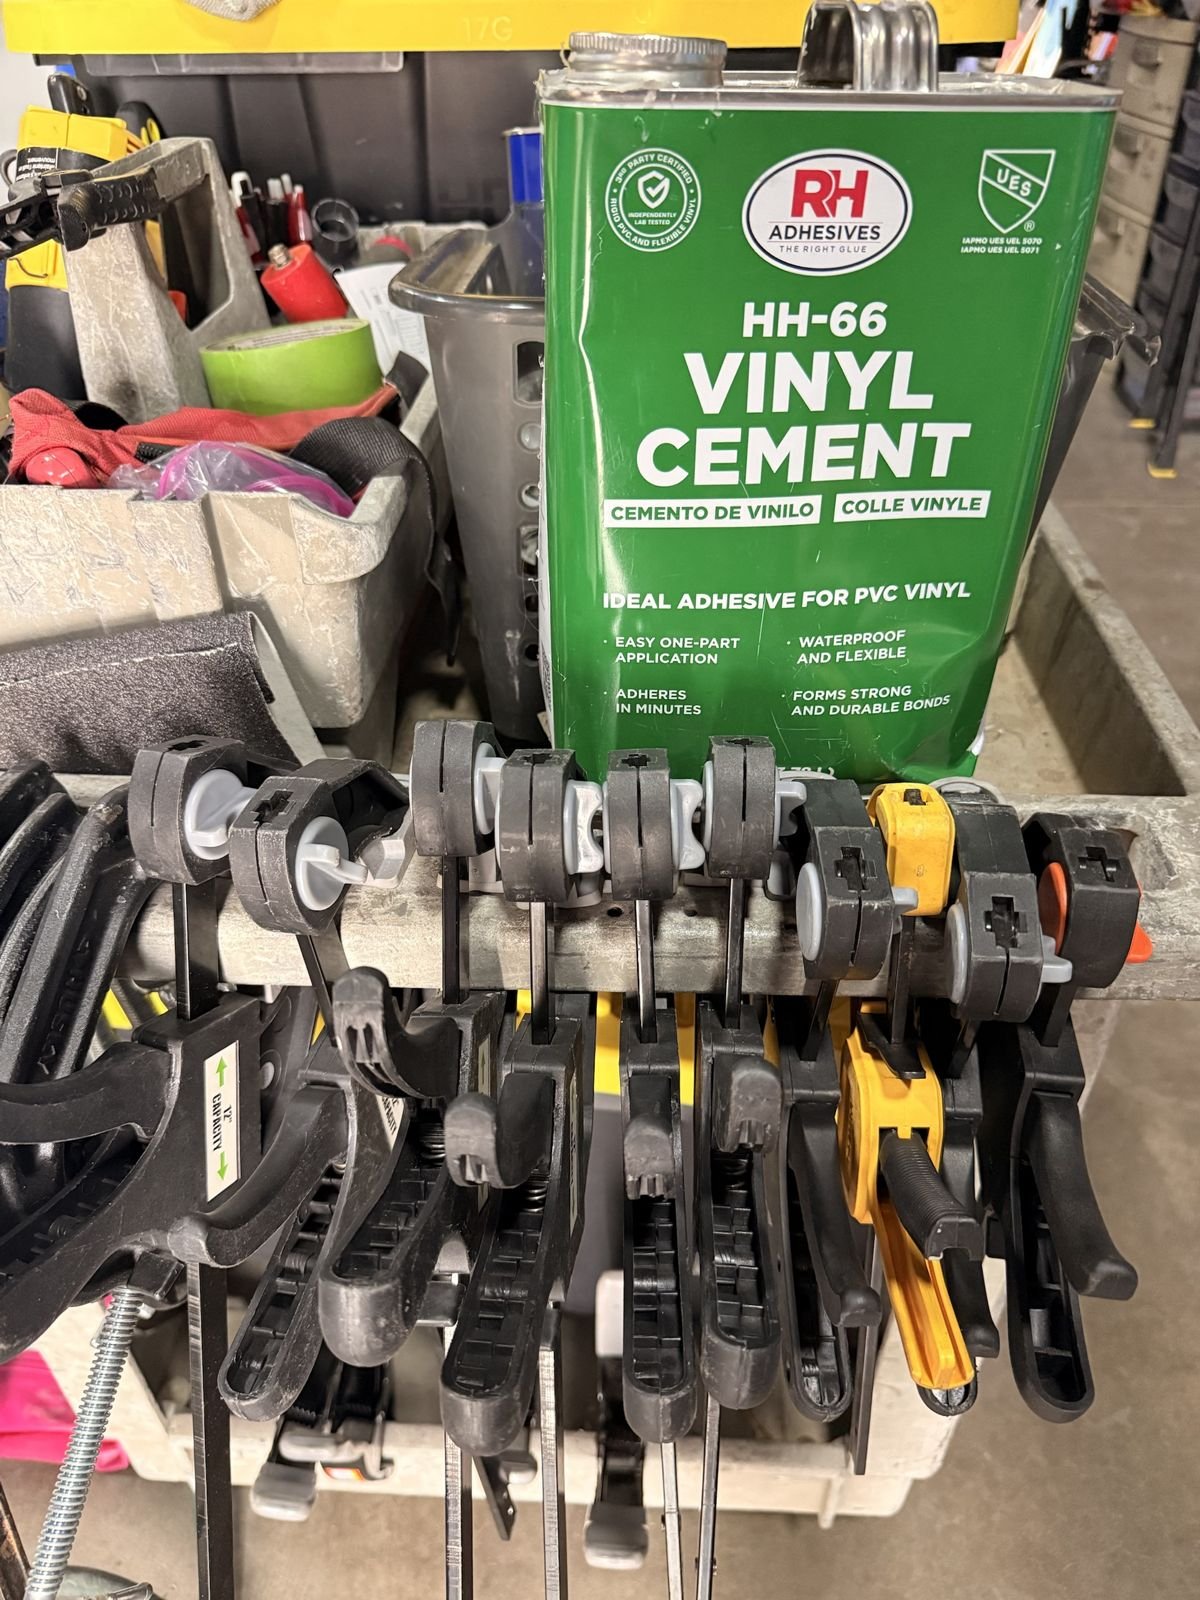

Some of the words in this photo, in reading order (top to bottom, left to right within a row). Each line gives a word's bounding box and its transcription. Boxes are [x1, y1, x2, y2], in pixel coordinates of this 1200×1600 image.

[627, 153, 655, 169] PARTY
[657, 154, 693, 184] CERTIFIED
[996, 168, 1032, 197] UES
[791, 169, 869, 218] RH
[610, 198, 621, 223] RIGID
[617, 223, 633, 239] PVC
[632, 236, 650, 247] AND
[652, 224, 686, 247] FLEXIBLE
[684, 198, 696, 224] VINYL
[769, 225, 881, 241] ADHESIVES
[962, 237, 988, 245] IAPMO
[989, 237, 1005, 245] UES
[1006, 237, 1021, 245] UEL
[1022, 237, 1043, 245] 5070
[780, 245, 799, 253] THE
[803, 245, 836, 253] RIGHT
[839, 245, 867, 253] GLUE
[960, 246, 986, 254] IAPMO
[987, 246, 1003, 254] UES
[1004, 246, 1019, 254] UEL
[1020, 246, 1040, 254] 5071
[742, 301, 888, 338] HH-66
[683, 350, 934, 414] VINYL
[636, 422, 971, 487] CEMENT
[611, 506, 709, 521] CEMENTO
[714, 505, 741, 520] DE
[747, 502, 814, 520] VINILO
[841, 498, 905, 515] COLLE
[911, 496, 983, 512] VINYLE
[603, 592, 672, 609] IDEAL
[677, 592, 796, 609] ADHESIVE
[801, 589, 849, 608] FOR
[854, 585, 899, 604] PVC
[904, 582, 972, 601] VINYL
[615, 636, 656, 648] EASY
[659, 637, 741, 649] ONE-PART
[799, 629, 906, 648] WATERPROOF
[615, 652, 718, 664] APPLICATION
[796, 652, 831, 664] AND
[836, 646, 907, 663] FLEXIBLE
[616, 688, 687, 700] ADHERES
[793, 689, 846, 701] FORMS
[850, 685, 912, 700] STRONG
[616, 703, 631, 714] IN
[636, 703, 702, 715] MINUTES
[791, 705, 825, 716] AND
[829, 701, 900, 716] DURABLE
[903, 694, 951, 712] BONDS
[212, 1093, 222, 1152] CAPACITY
